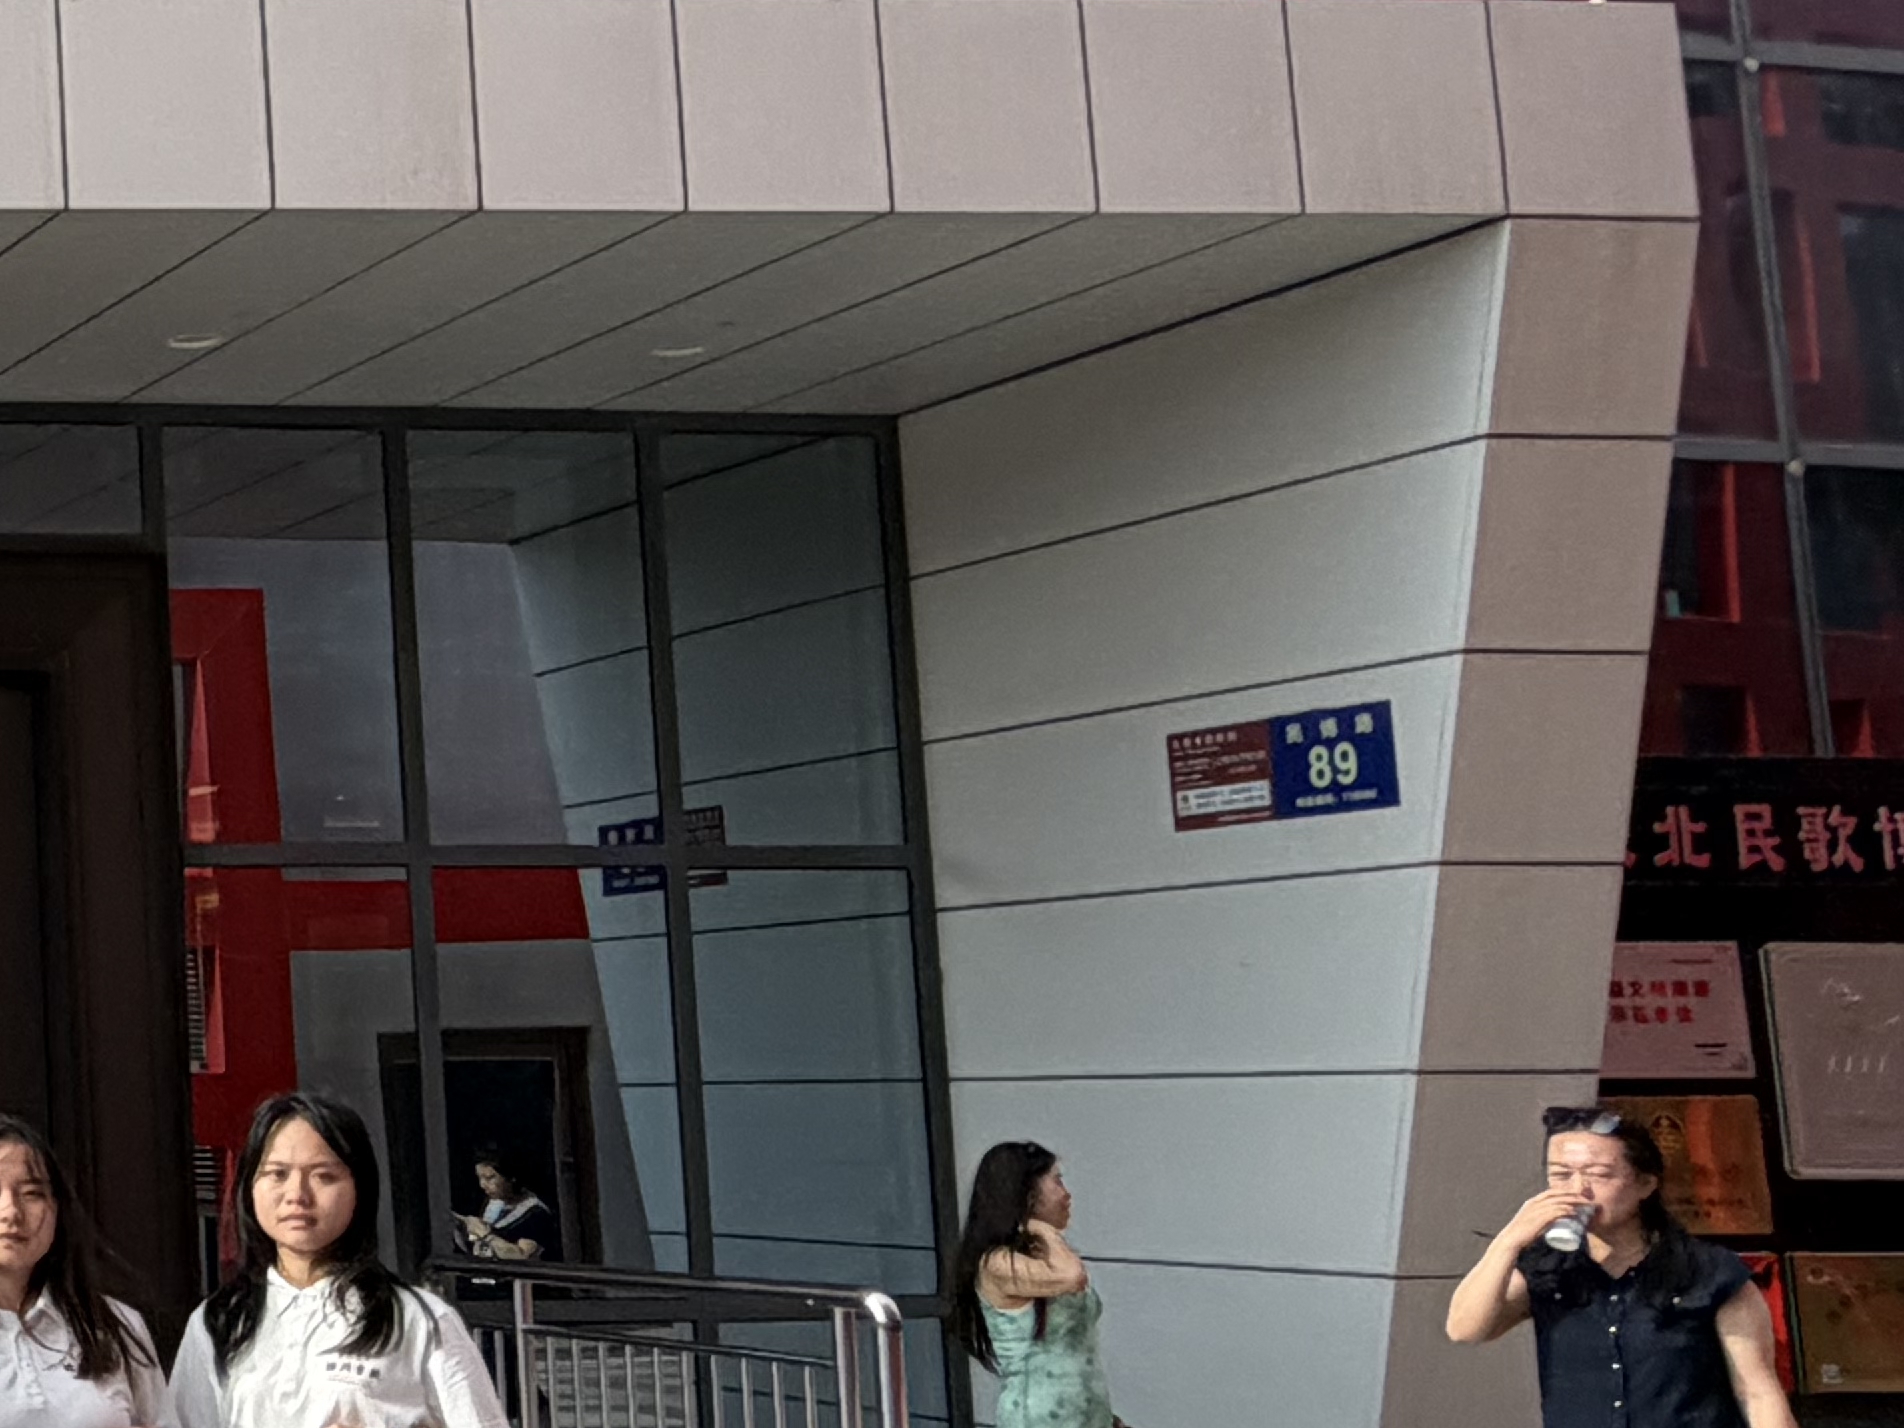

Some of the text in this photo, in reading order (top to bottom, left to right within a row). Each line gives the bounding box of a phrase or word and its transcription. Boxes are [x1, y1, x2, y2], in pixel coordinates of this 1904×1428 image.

[1308, 741, 1358, 788] 89
[1625, 803, 1904, 873] 北民歌
